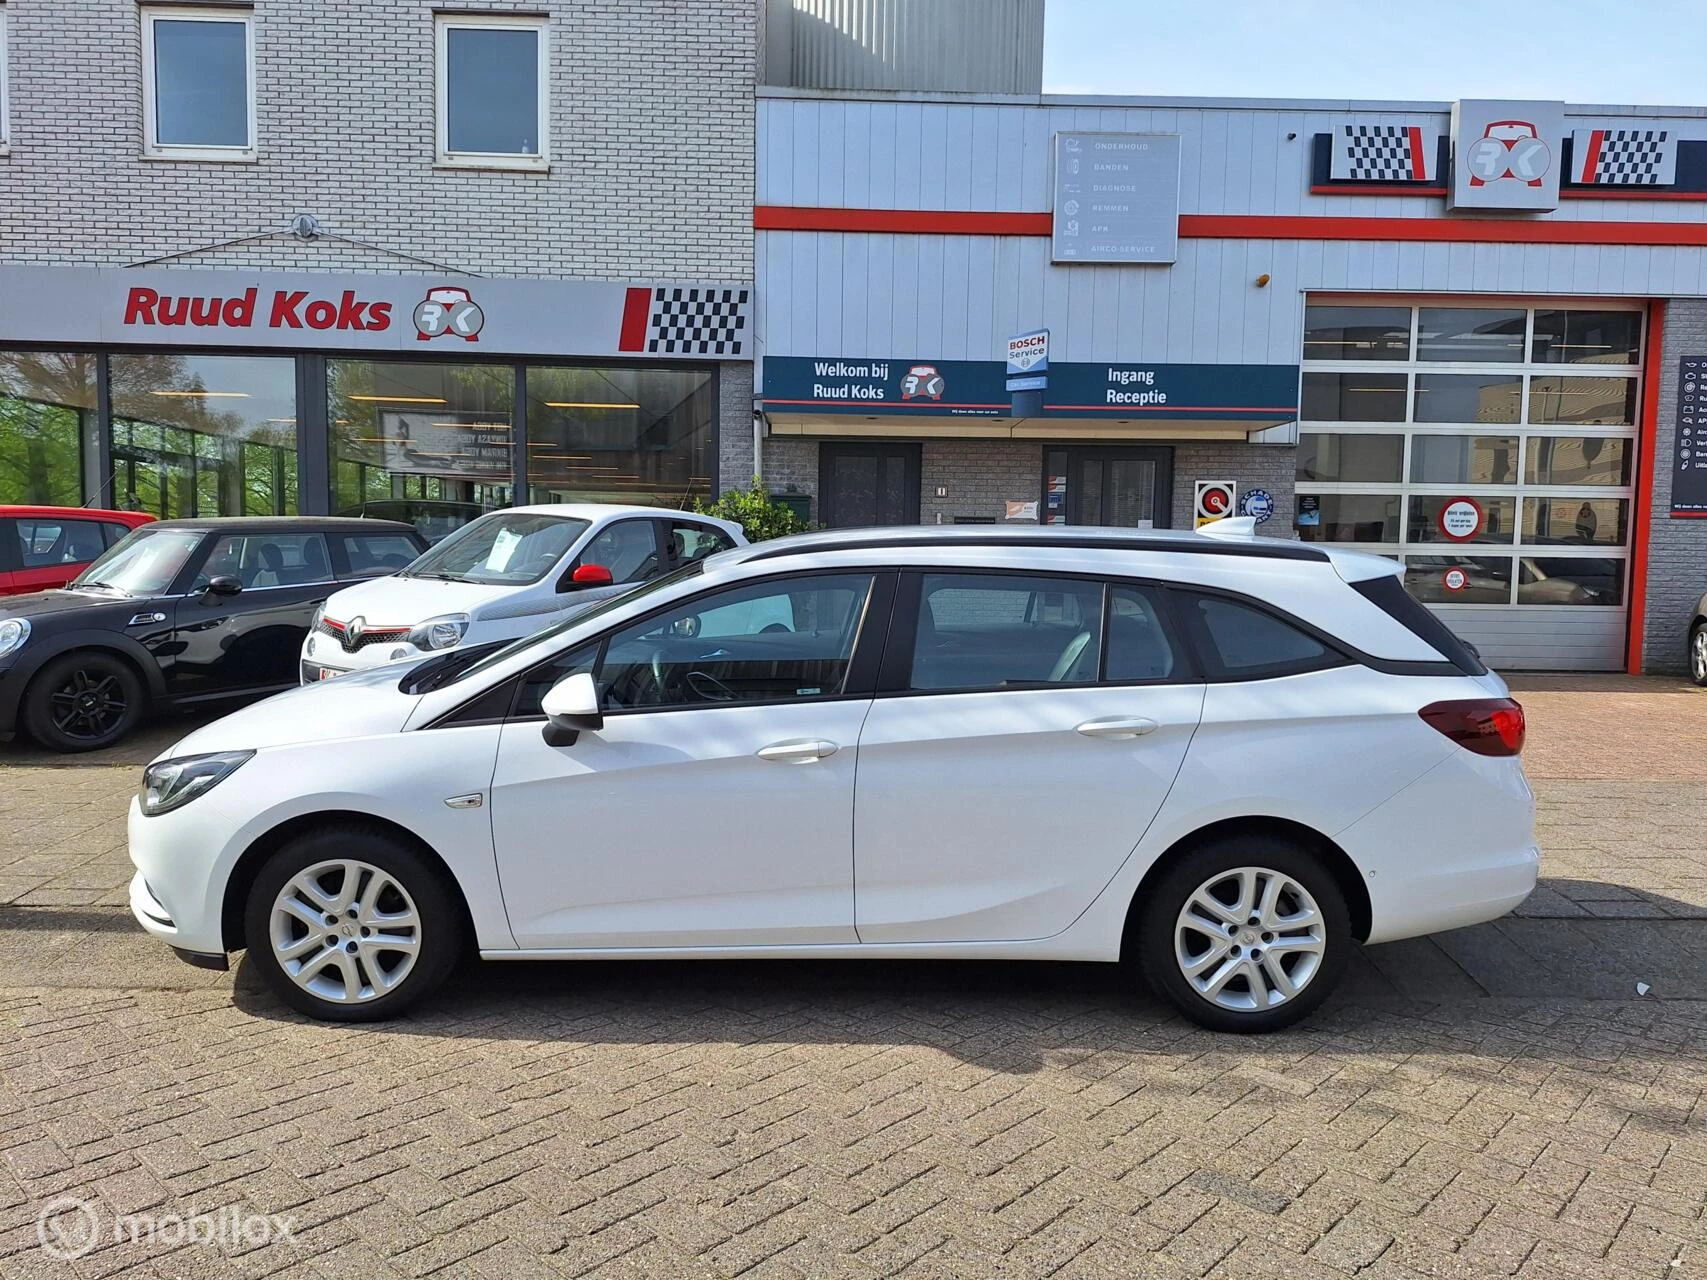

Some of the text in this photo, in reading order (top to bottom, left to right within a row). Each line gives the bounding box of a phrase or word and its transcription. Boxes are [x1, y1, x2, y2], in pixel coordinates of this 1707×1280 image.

[124, 287, 393, 331] Ruud Koks
[1010, 335, 1045, 350] BOSCH
[1009, 347, 1045, 359] Service
[814, 362, 889, 381] Welkom bij
[1108, 368, 1154, 385] Ingang
[813, 384, 884, 399] Ruud Koks
[1106, 389, 1167, 406] Receptie
